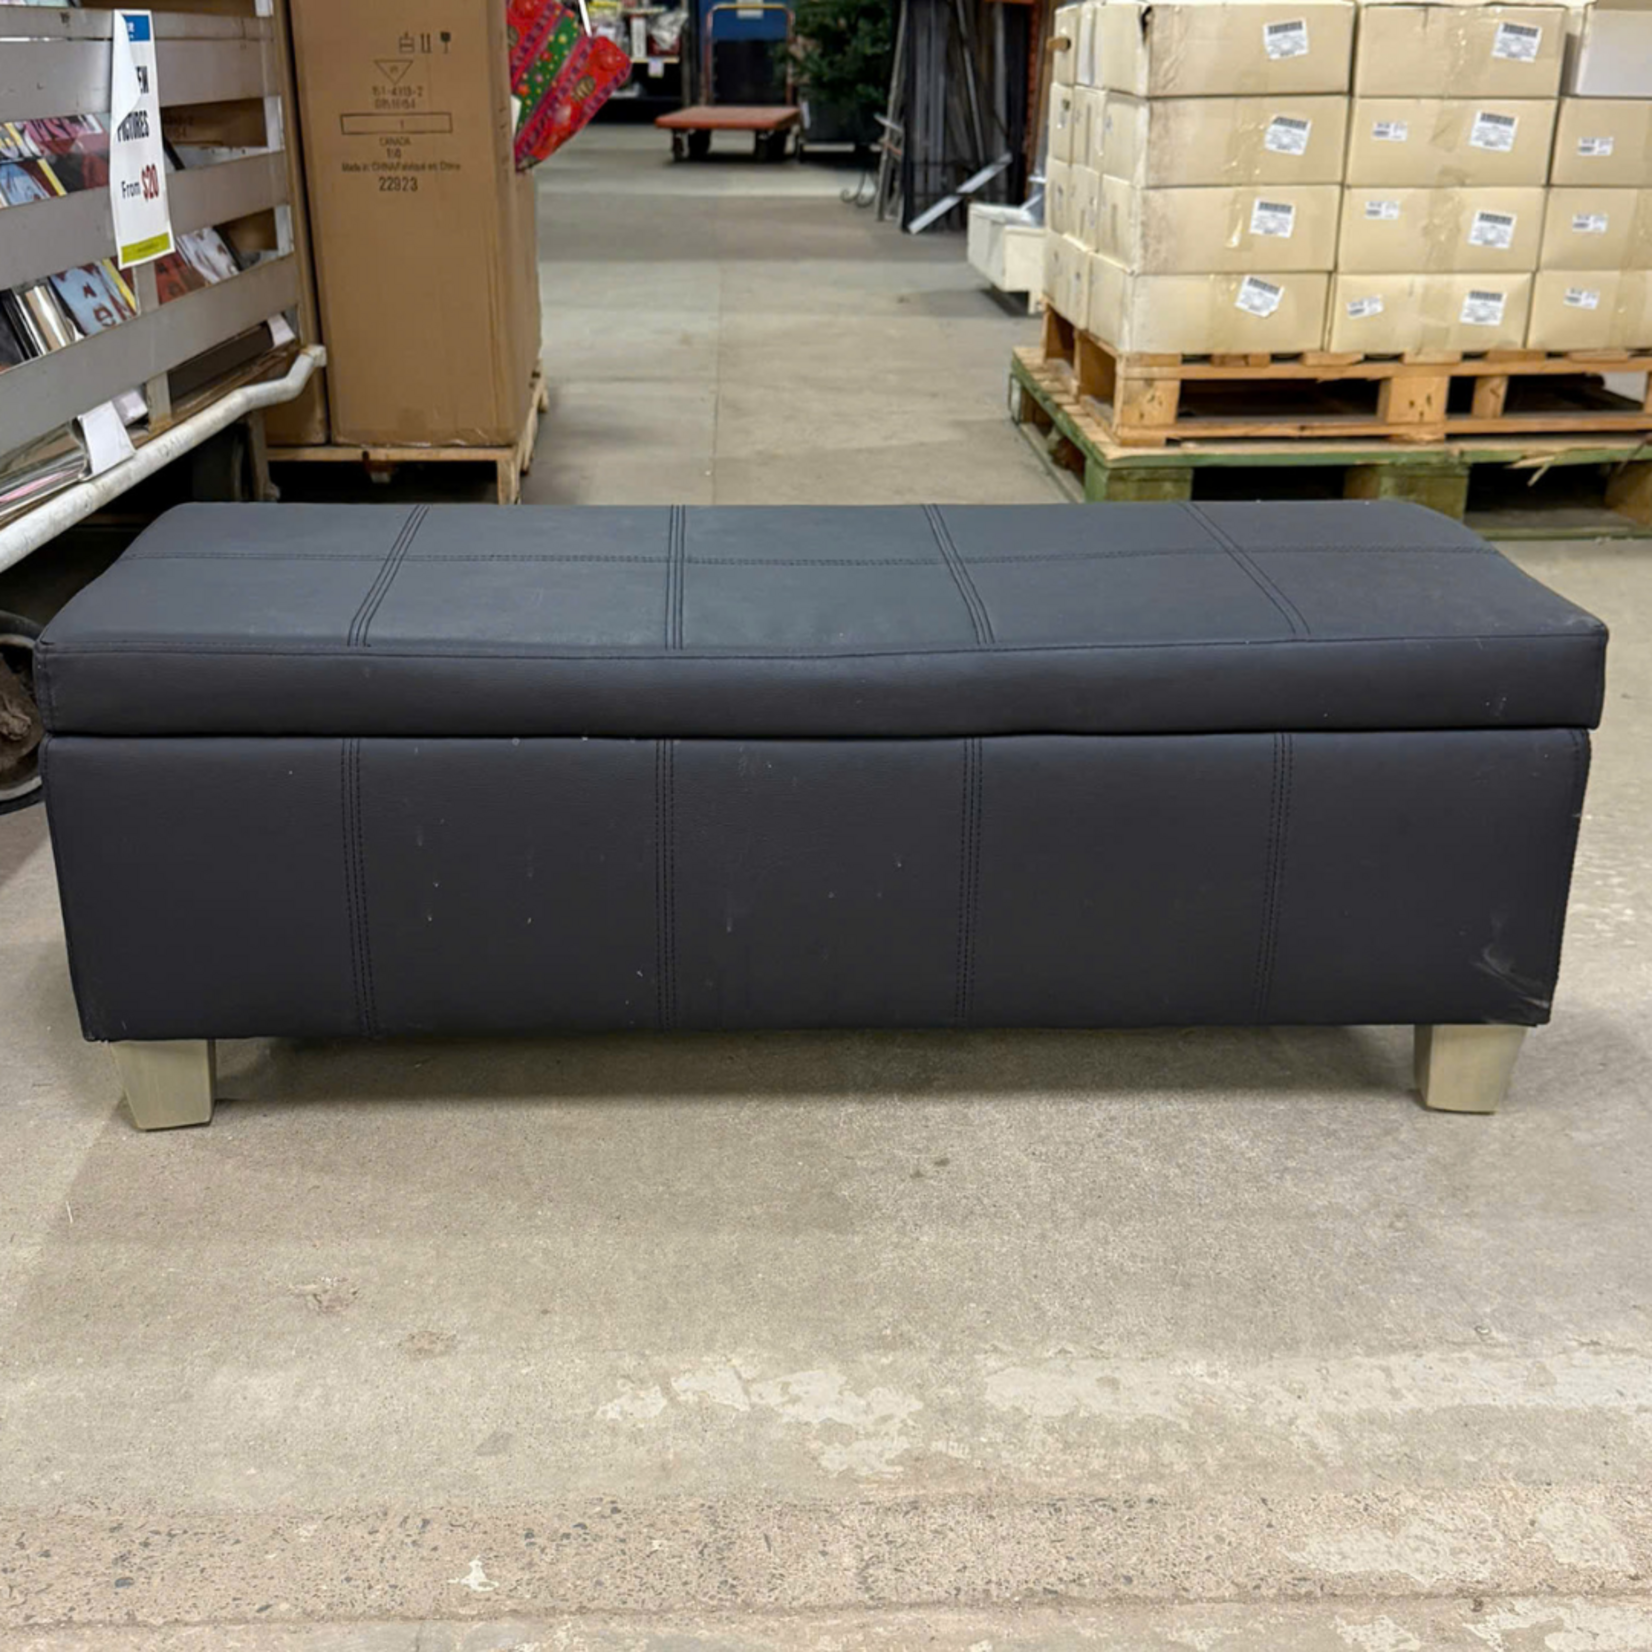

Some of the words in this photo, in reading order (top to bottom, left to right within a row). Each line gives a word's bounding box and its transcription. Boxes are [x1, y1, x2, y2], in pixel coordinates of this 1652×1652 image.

[379, 137, 411, 146] CANADA
[341, 162, 361, 172] Made
[121, 180, 141, 199] From
[141, 163, 159, 203] $20
[378, 176, 418, 192] 22923
